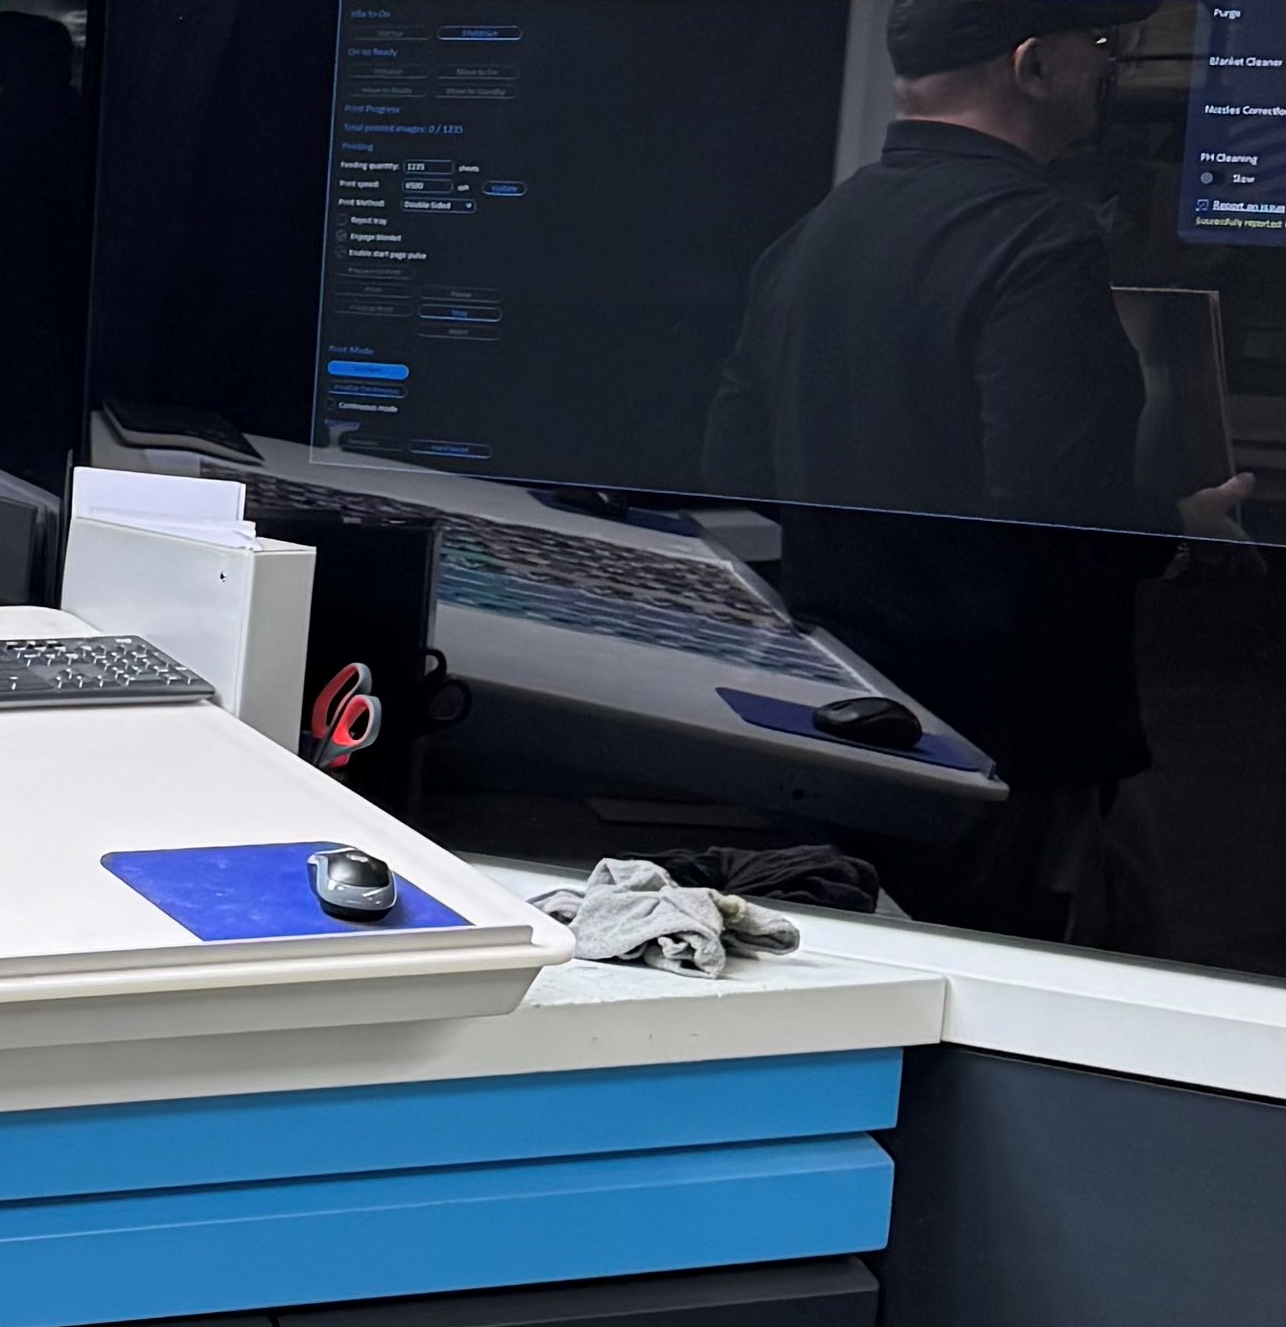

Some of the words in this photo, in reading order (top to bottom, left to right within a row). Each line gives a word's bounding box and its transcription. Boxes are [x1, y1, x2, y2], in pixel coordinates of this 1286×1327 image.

[1214, 8, 1241, 20] Purge
[1209, 57, 1244, 67] Blanket
[1246, 57, 1283, 67] Cleaner
[1216, 153, 1258, 165] Cleaning
